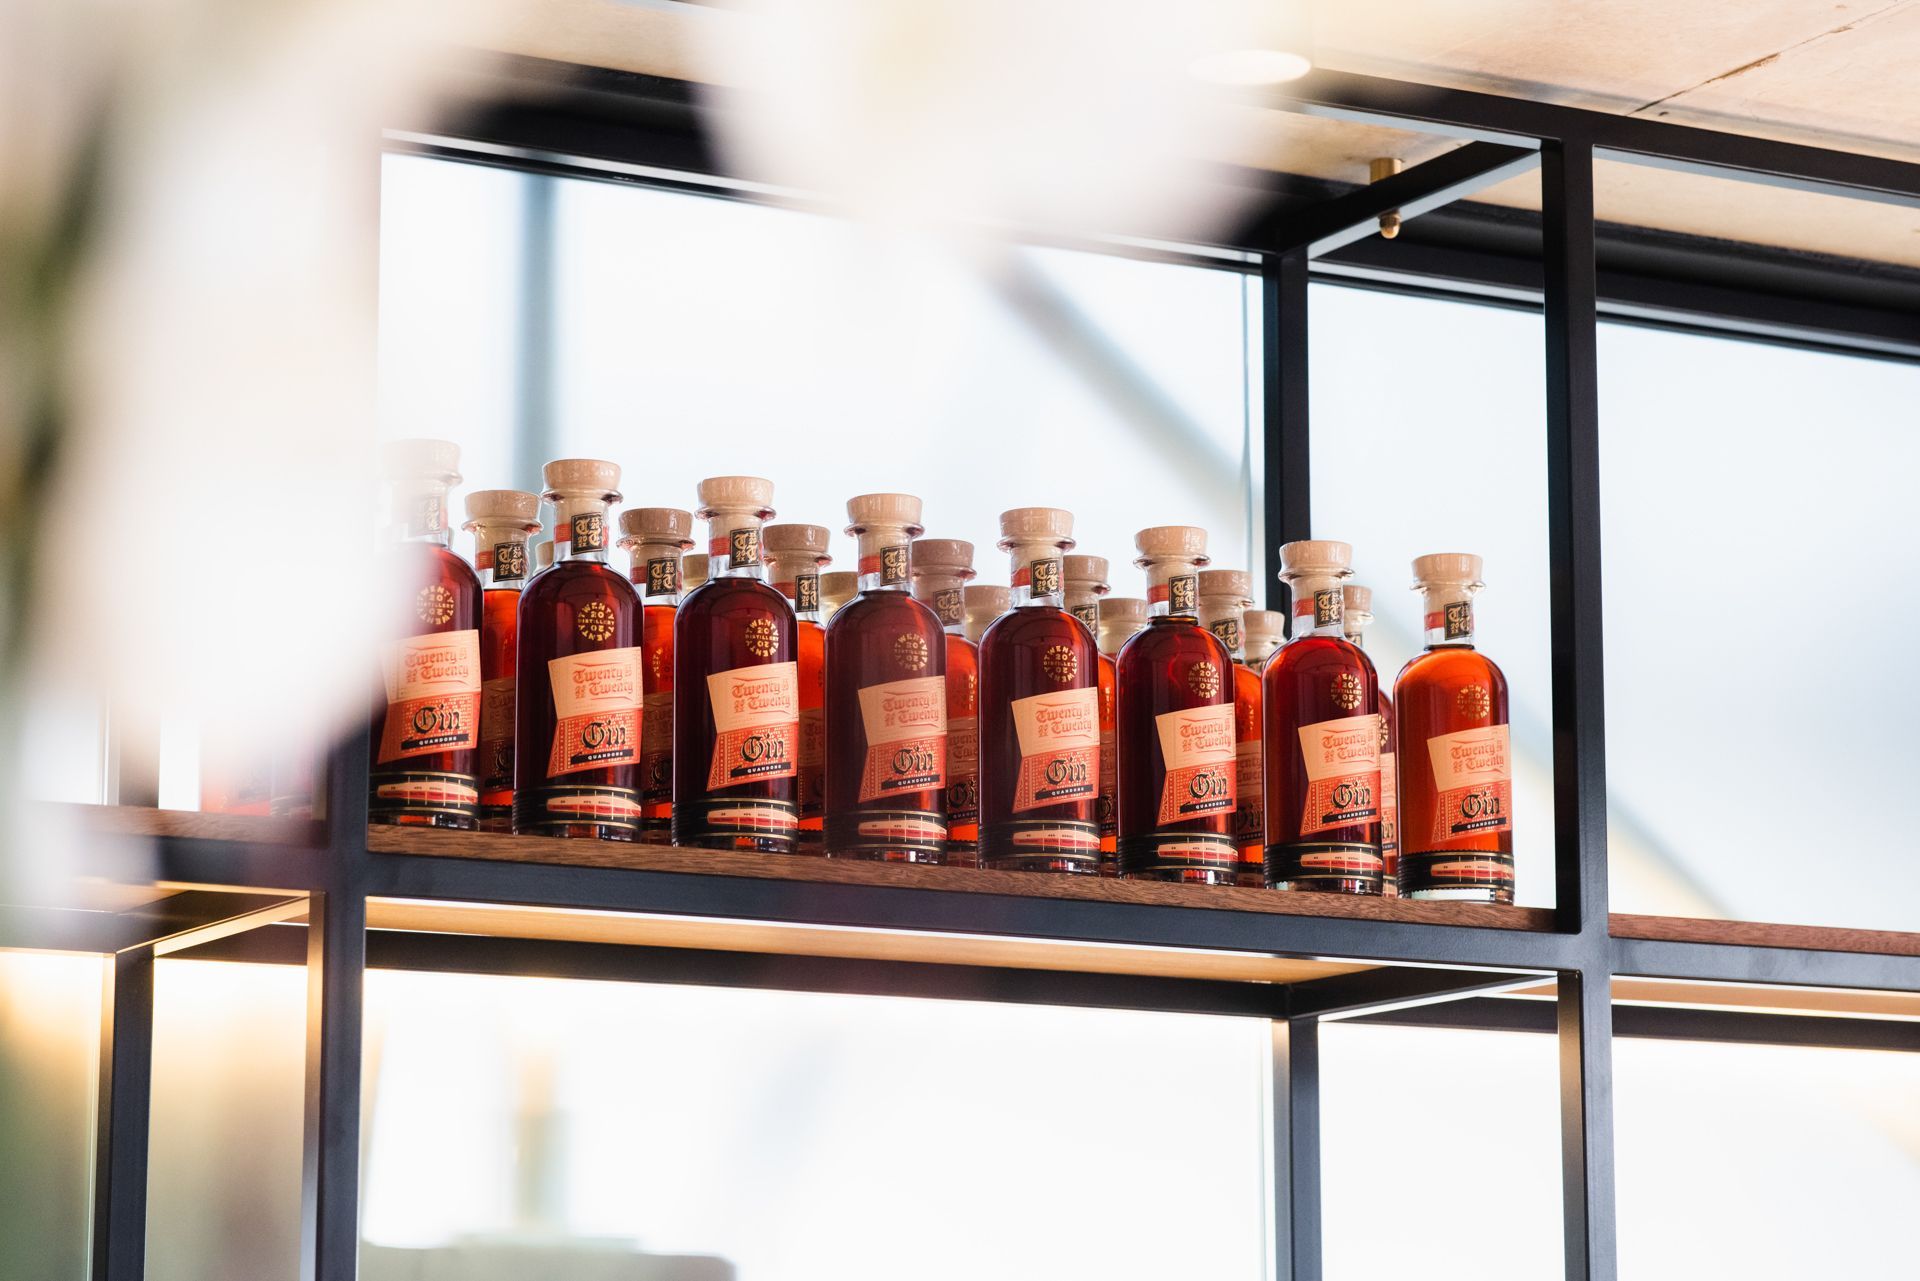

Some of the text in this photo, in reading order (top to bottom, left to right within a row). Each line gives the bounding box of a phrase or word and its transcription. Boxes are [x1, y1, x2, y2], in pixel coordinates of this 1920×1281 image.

[405, 651, 456, 667] Twenty
[421, 665, 469, 680] Twenty
[573, 667, 622, 684] Twenty
[589, 681, 633, 695] Twenty
[732, 681, 780, 698] Twenty
[748, 695, 790, 709] Twenty
[882, 697, 929, 712] Twenty
[413, 704, 460, 734] Gin
[898, 710, 939, 723] Twenty
[1035, 707, 1082, 723] Twenty
[582, 719, 626, 749] Gin
[1051, 719, 1092, 734] Twenty
[1180, 721, 1223, 738] Twenty
[741, 732, 784, 762] Gin
[1194, 735, 1231, 749] Twenty
[1322, 733, 1366, 749] Twenty
[1337, 745, 1374, 759] Twenty
[1450, 743, 1495, 760] Twenty
[892, 745, 934, 775] Gin
[1465, 755, 1504, 769] Twenty
[1044, 756, 1087, 785] Gin
[1189, 771, 1228, 799] Gin
[1332, 782, 1371, 809] Gin
[1461, 791, 1500, 818] Gin
